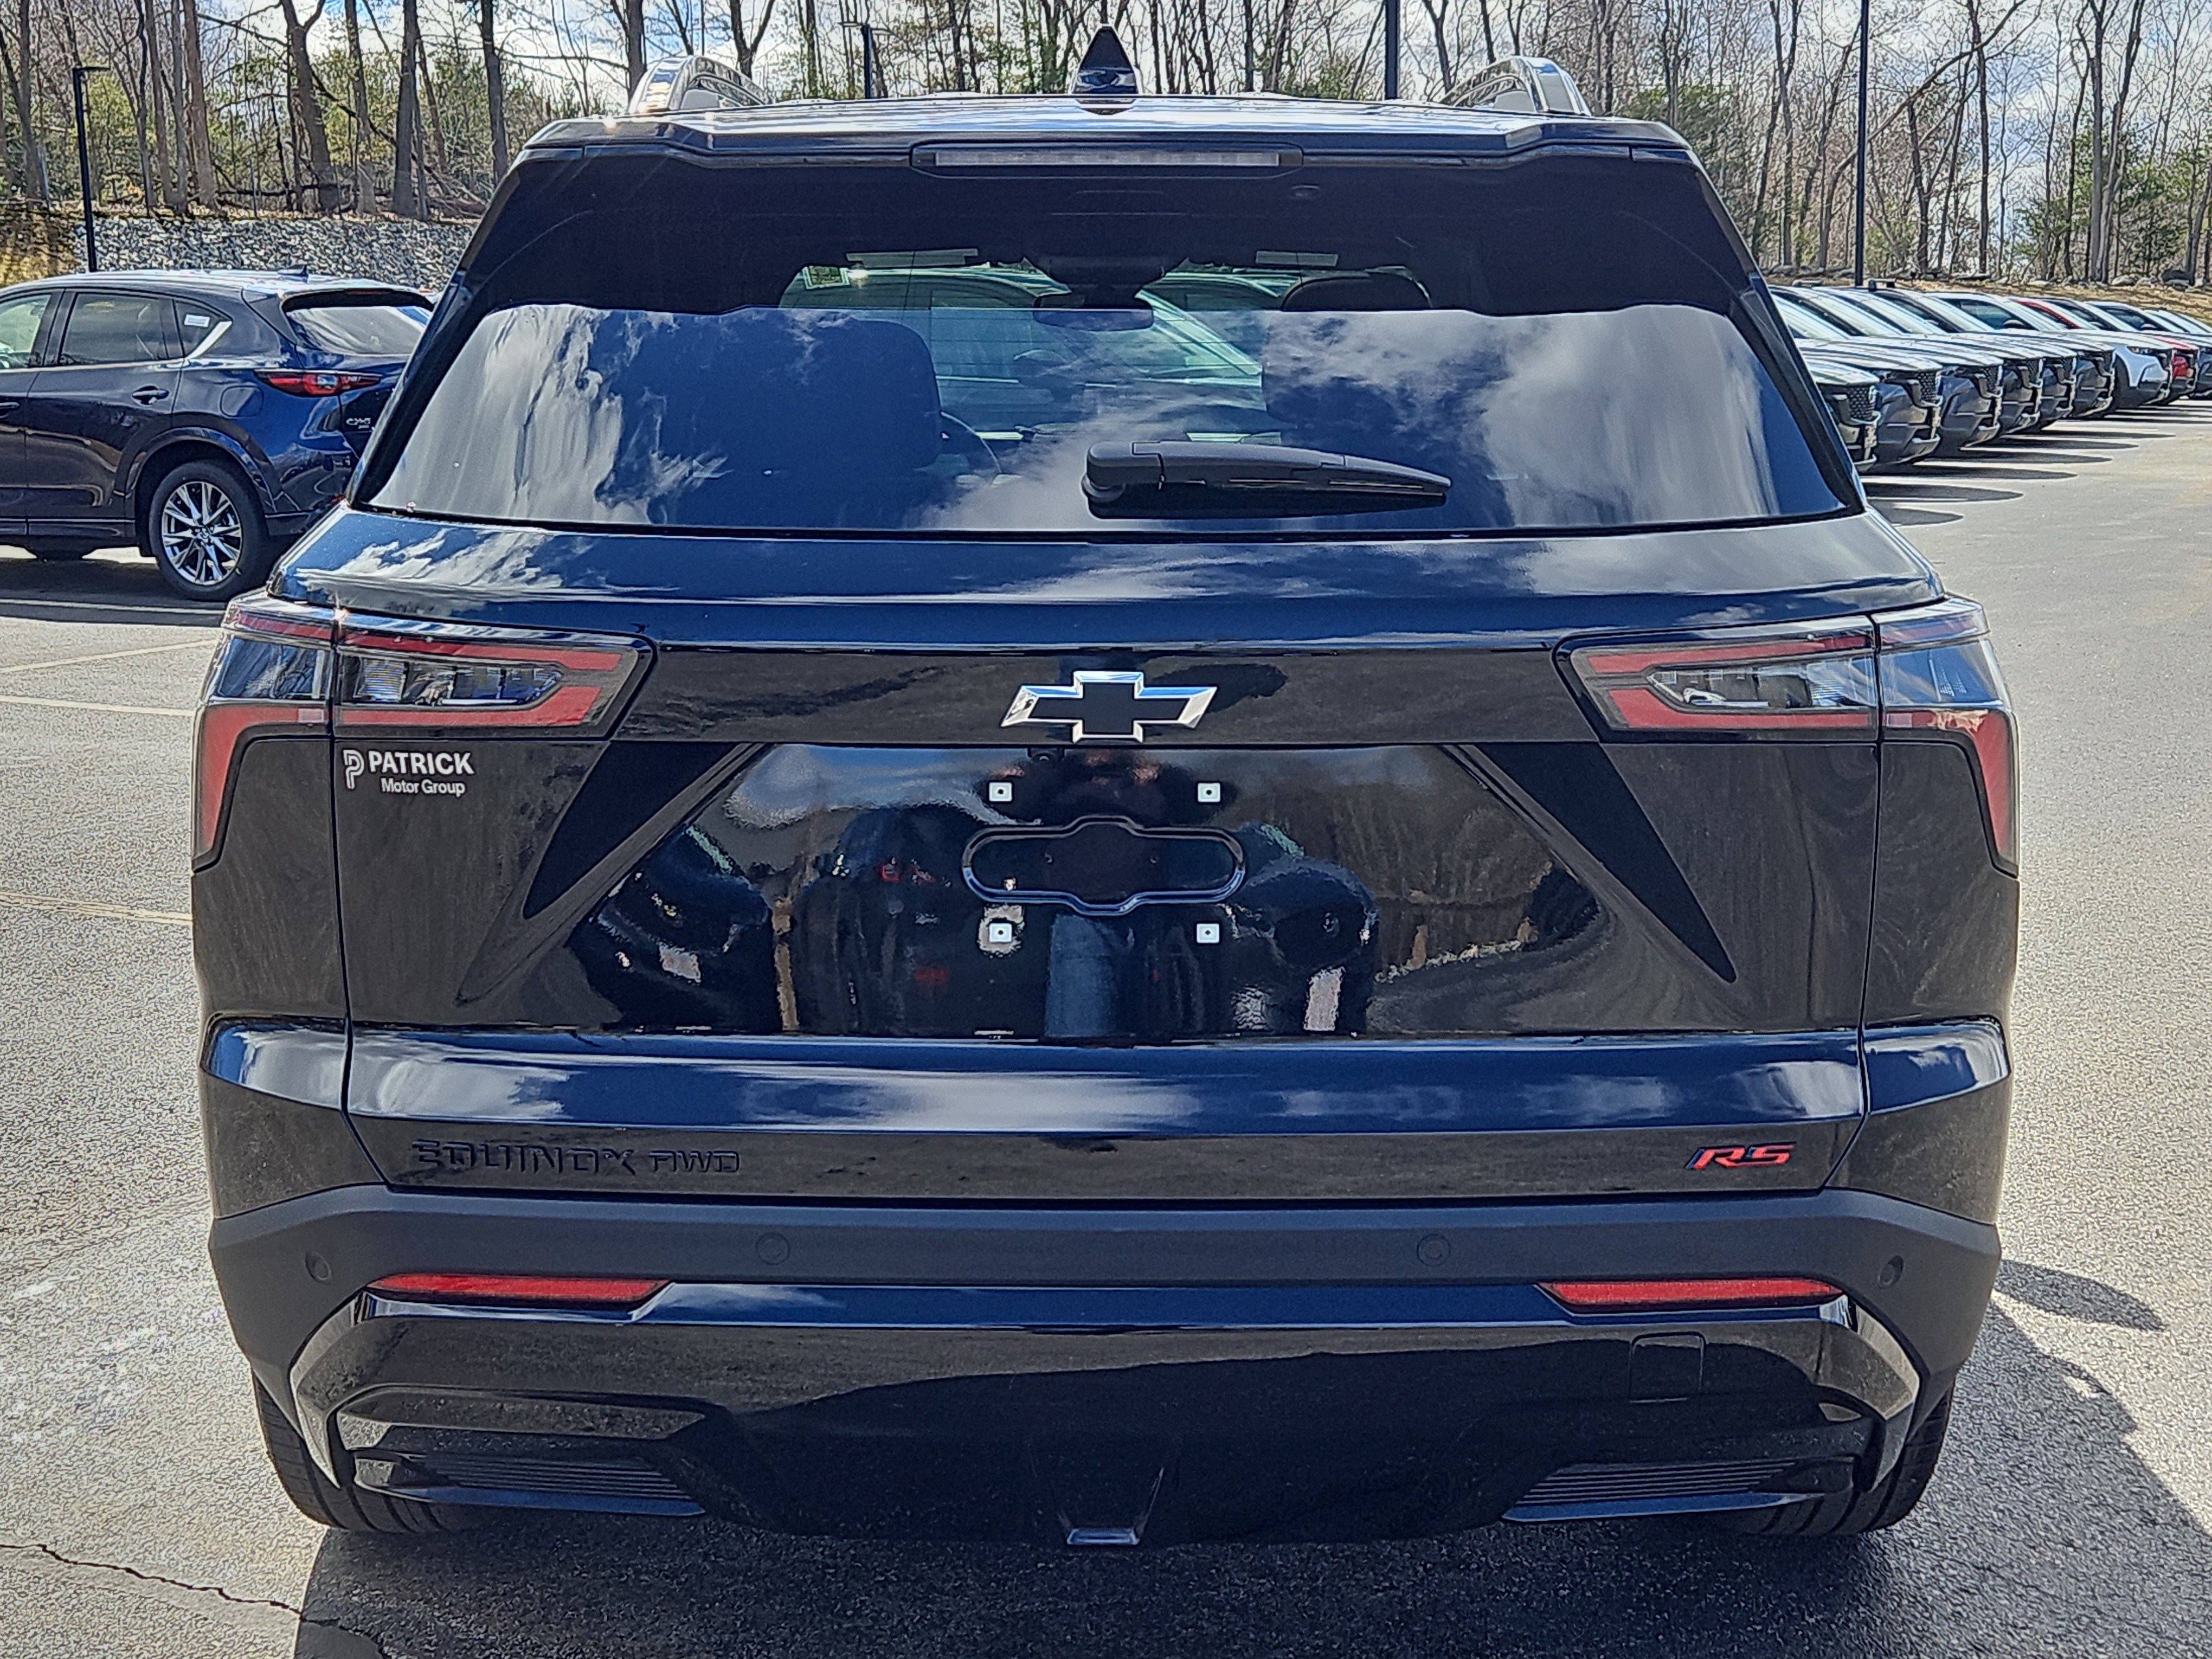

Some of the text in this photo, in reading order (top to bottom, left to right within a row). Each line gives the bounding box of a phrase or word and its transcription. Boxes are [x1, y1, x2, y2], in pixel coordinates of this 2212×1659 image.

[368, 750, 475, 775] PATRICK
[381, 777, 466, 798] Motor Group
[413, 1140, 740, 1175] EQUINOX AWD
[1683, 1141, 1797, 1170] RS
